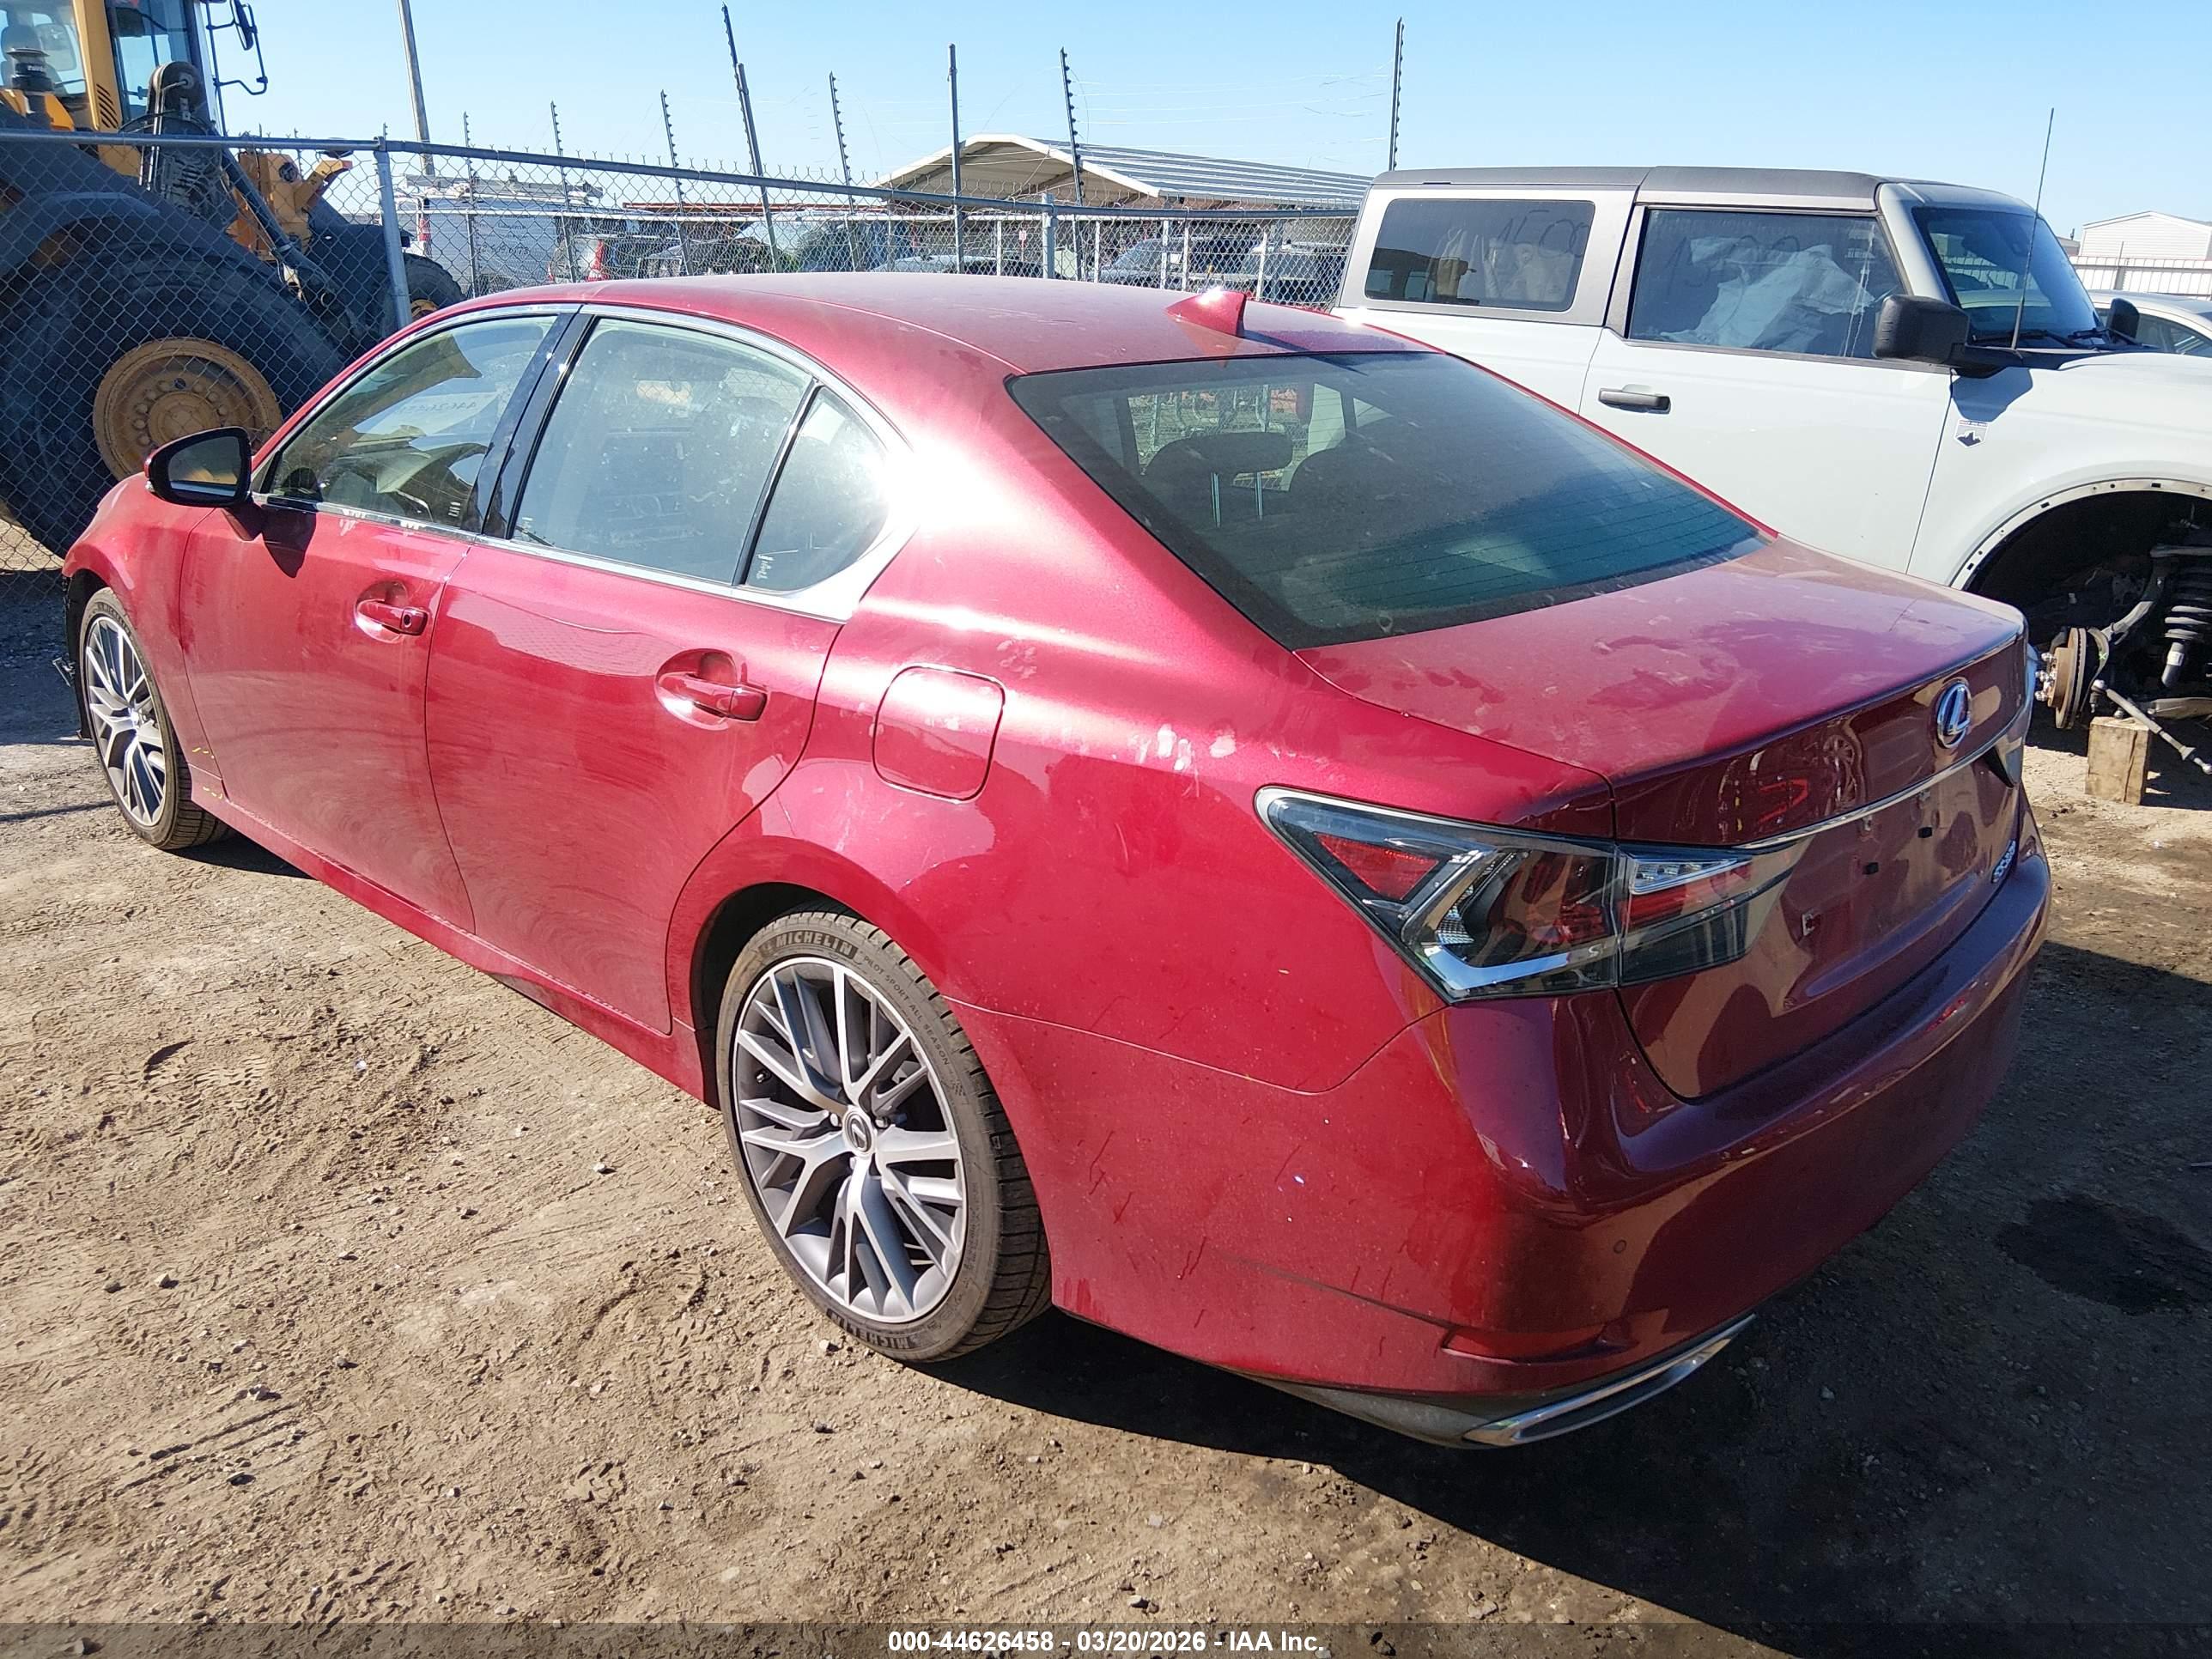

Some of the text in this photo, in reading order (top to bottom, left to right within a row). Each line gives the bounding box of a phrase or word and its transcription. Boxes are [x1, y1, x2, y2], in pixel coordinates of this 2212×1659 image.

[775, 932, 853, 954] MICHELIN
[863, 956, 950, 1066] PILOT SPORT ALL SEASON
